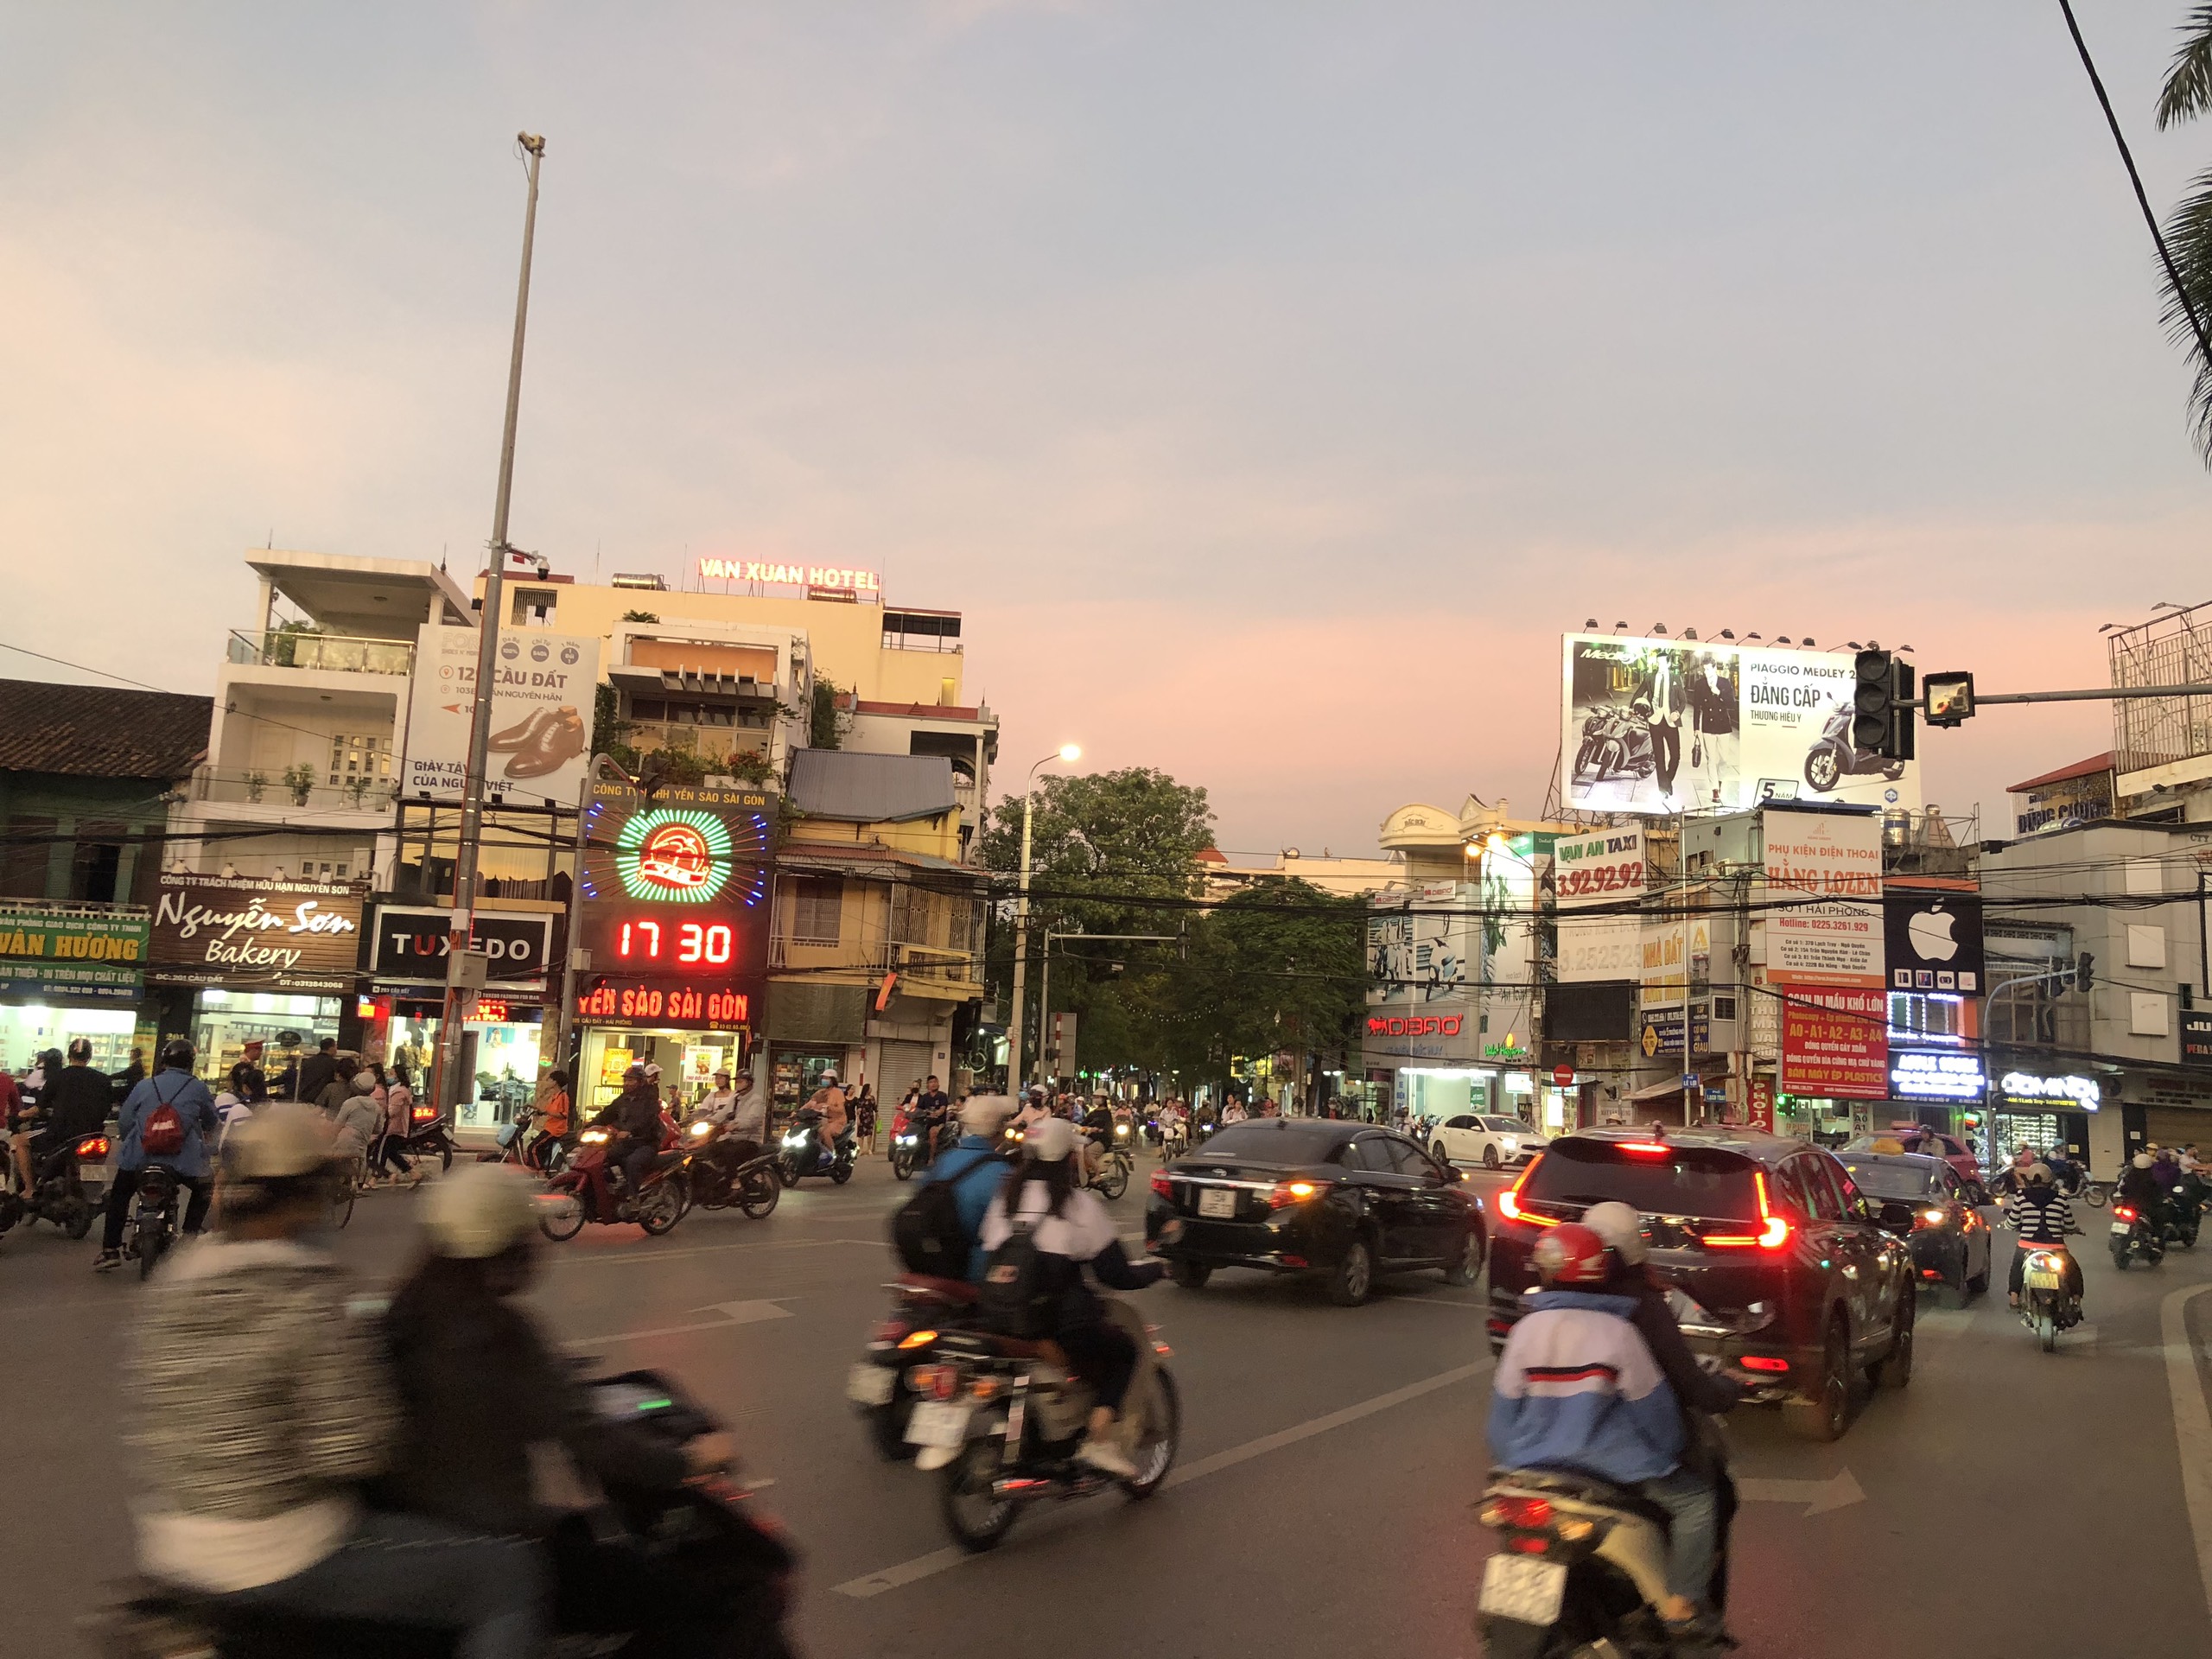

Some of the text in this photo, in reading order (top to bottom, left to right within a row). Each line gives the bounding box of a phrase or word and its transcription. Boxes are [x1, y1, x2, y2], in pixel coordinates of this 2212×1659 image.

[700, 557, 879, 590] VAN XUAN HOTEL
[531, 670, 568, 689] ĐẤT
[1751, 663, 1800, 675] PIAGGIO
[1803, 667, 1845, 679] MEDLEY
[1751, 676, 1821, 708] ĐẲNG CẤP
[415, 760, 443, 772] GIÀY
[413, 773, 437, 787] CỦA
[1761, 781, 1776, 798] 5
[593, 783, 622, 796] CÔNG
[674, 788, 694, 801] YẾN
[699, 791, 719, 804] SÀO
[744, 792, 766, 806] GÒN
[1559, 834, 1637, 863] VẠN AN TAXI
[1768, 843, 1878, 861] PHỤ KIỆN ĐIỆN THOẠI
[161, 874, 185, 886] CÔNG
[275, 881, 295, 893] HẠN
[332, 885, 350, 895] SƠN
[1556, 861, 1643, 897] 3.92.92.92
[1768, 858, 1879, 895] HẰNG LOZEN
[155, 891, 355, 940] Nguyễn Sơn
[1779, 917, 1869, 932] Hotline: 0225.3261.929
[54, 931, 139, 961] HƯƠNG
[205, 937, 302, 969] Bakery
[620, 921, 731, 963] 17 30
[578, 980, 748, 1020] YẾN SÀO SÀI GÒN
[1847, 992, 1865, 1011] KHỔ
[1866, 995, 1884, 1013] LỚN
[1789, 1023, 1883, 1042] A0 A1 A2 A3 A4
[1787, 1065, 1806, 1077] BÁN
[1808, 1067, 1829, 1079] MÁY
[1844, 1071, 1884, 1083] PLASTICS
